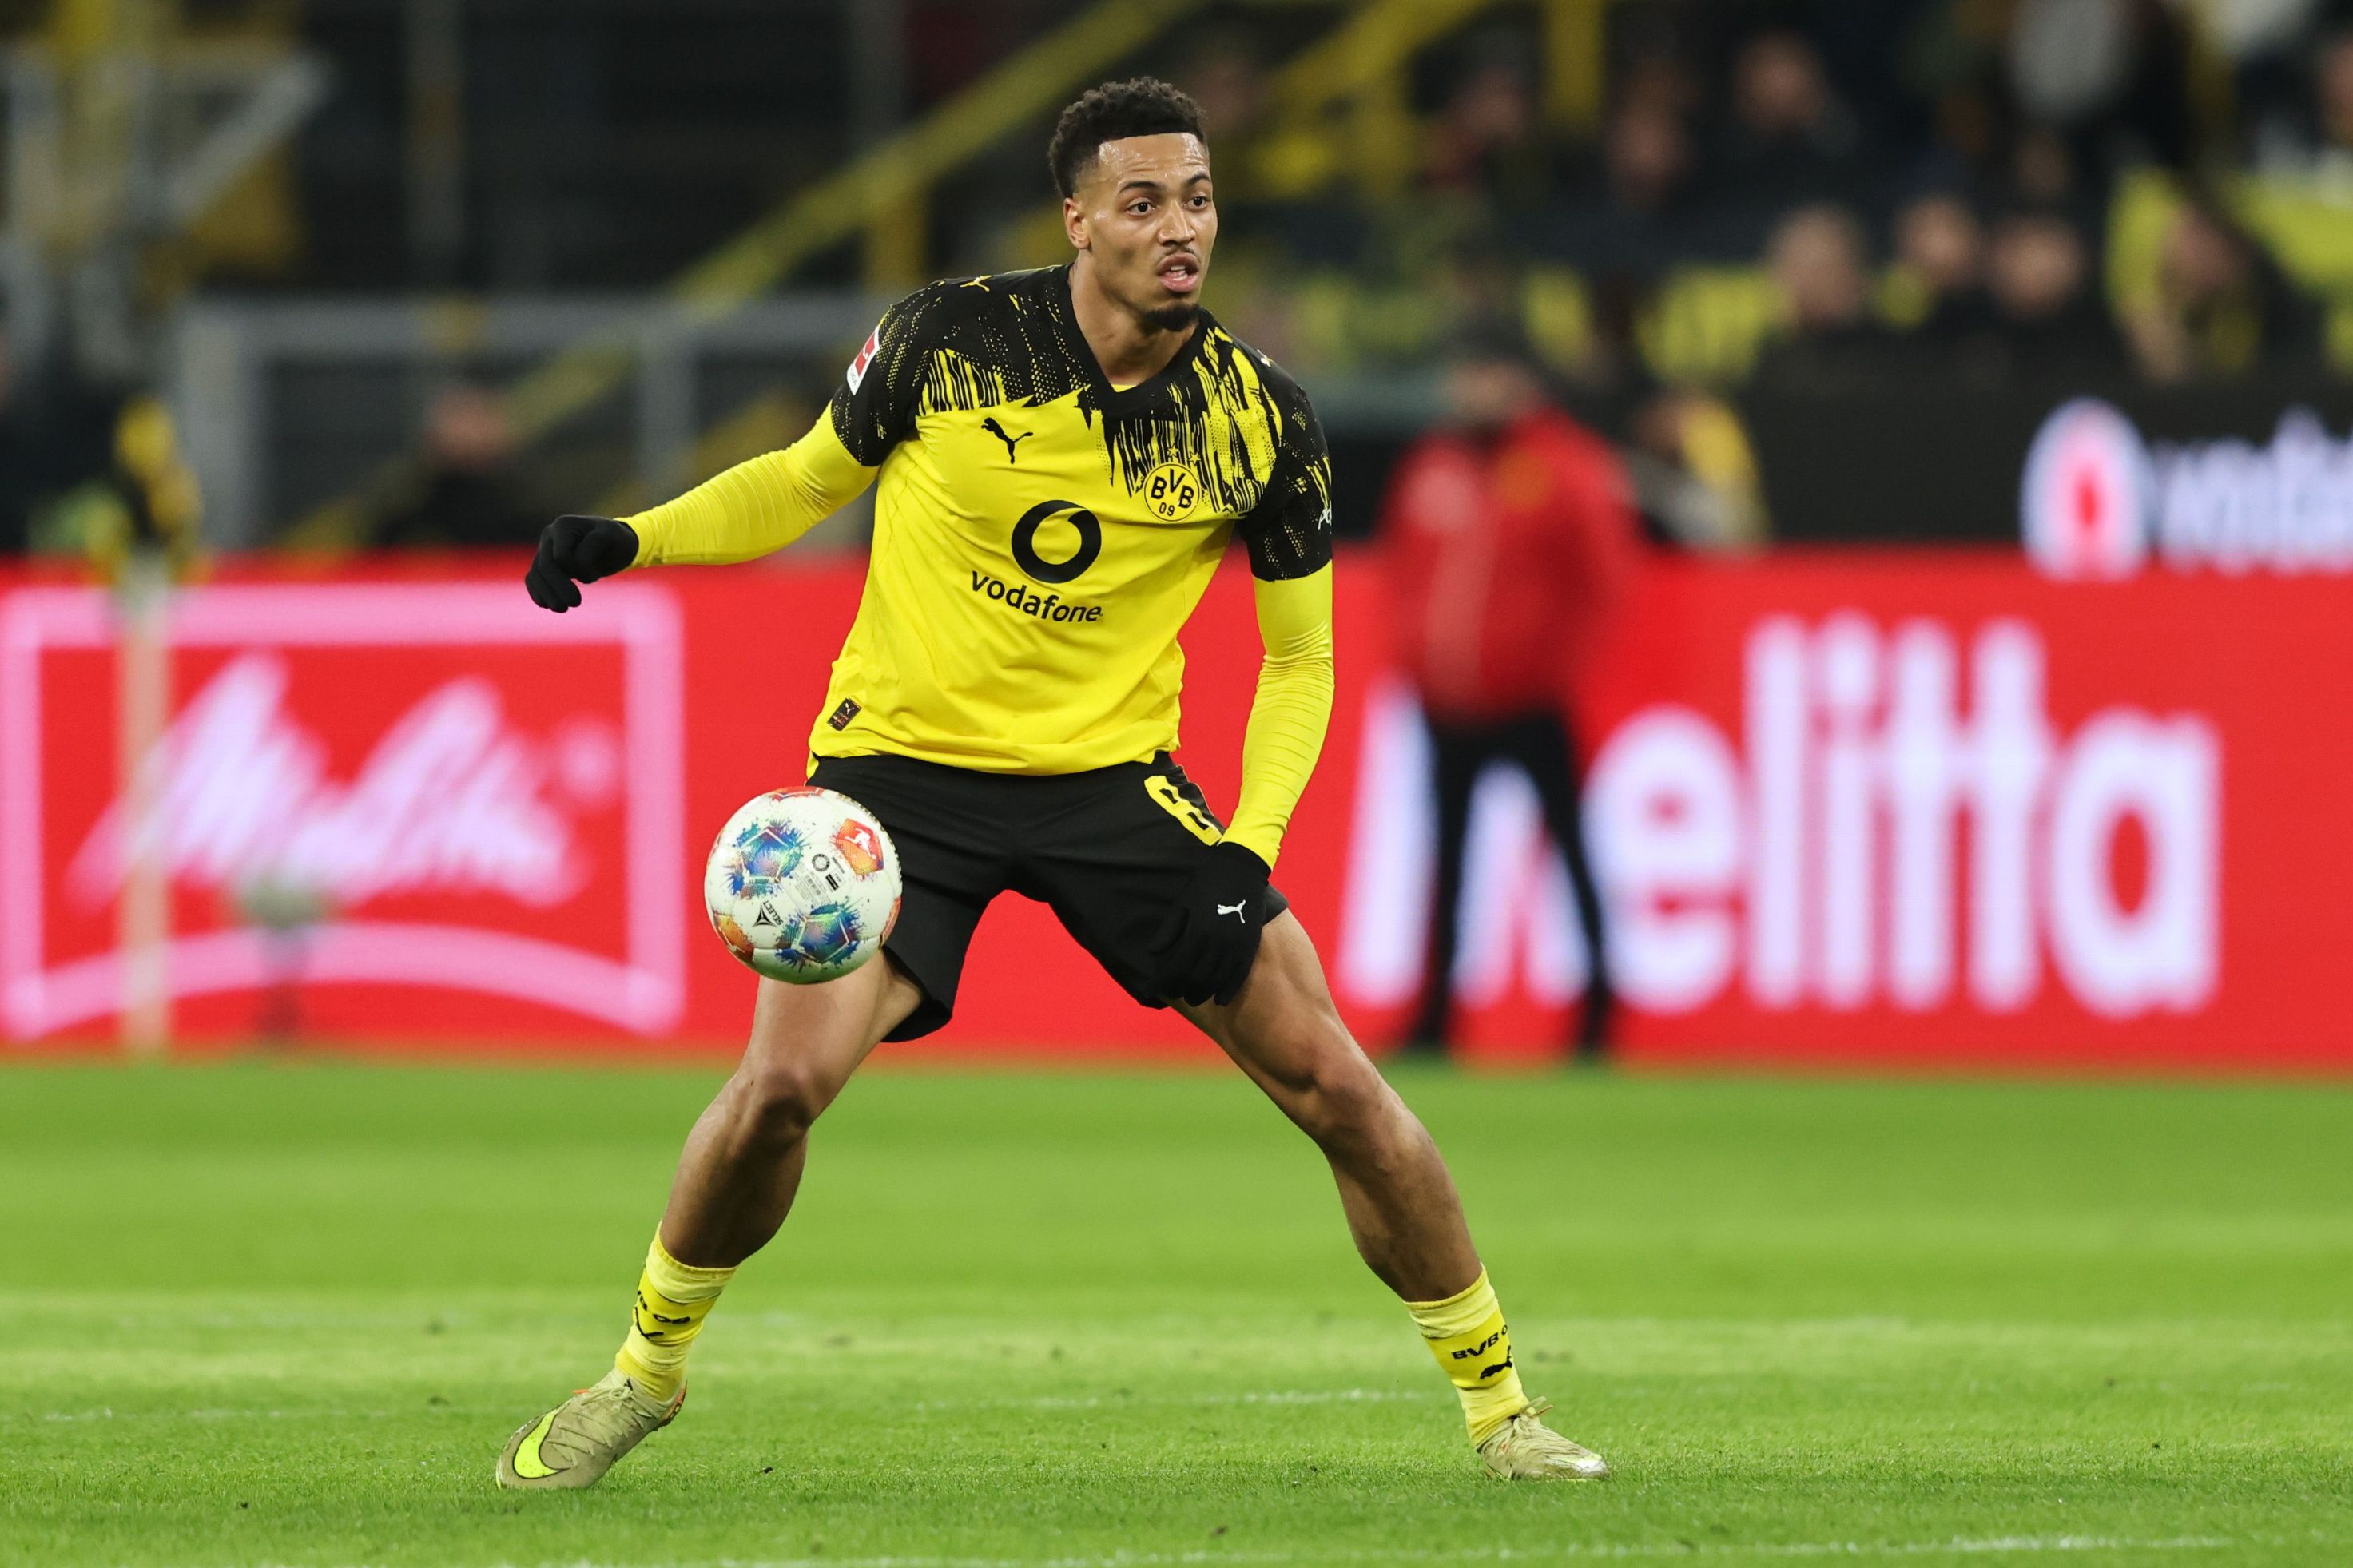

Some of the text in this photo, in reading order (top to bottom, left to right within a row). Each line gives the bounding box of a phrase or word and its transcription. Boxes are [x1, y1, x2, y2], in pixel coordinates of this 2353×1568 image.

[1151, 468, 1194, 509] BVB
[1159, 502, 1175, 517] 09
[972, 570, 1102, 622] vodafone
[1144, 775, 1222, 846] 8
[763, 900, 784, 925] SELECT
[1452, 1332, 1499, 1360] BVB
